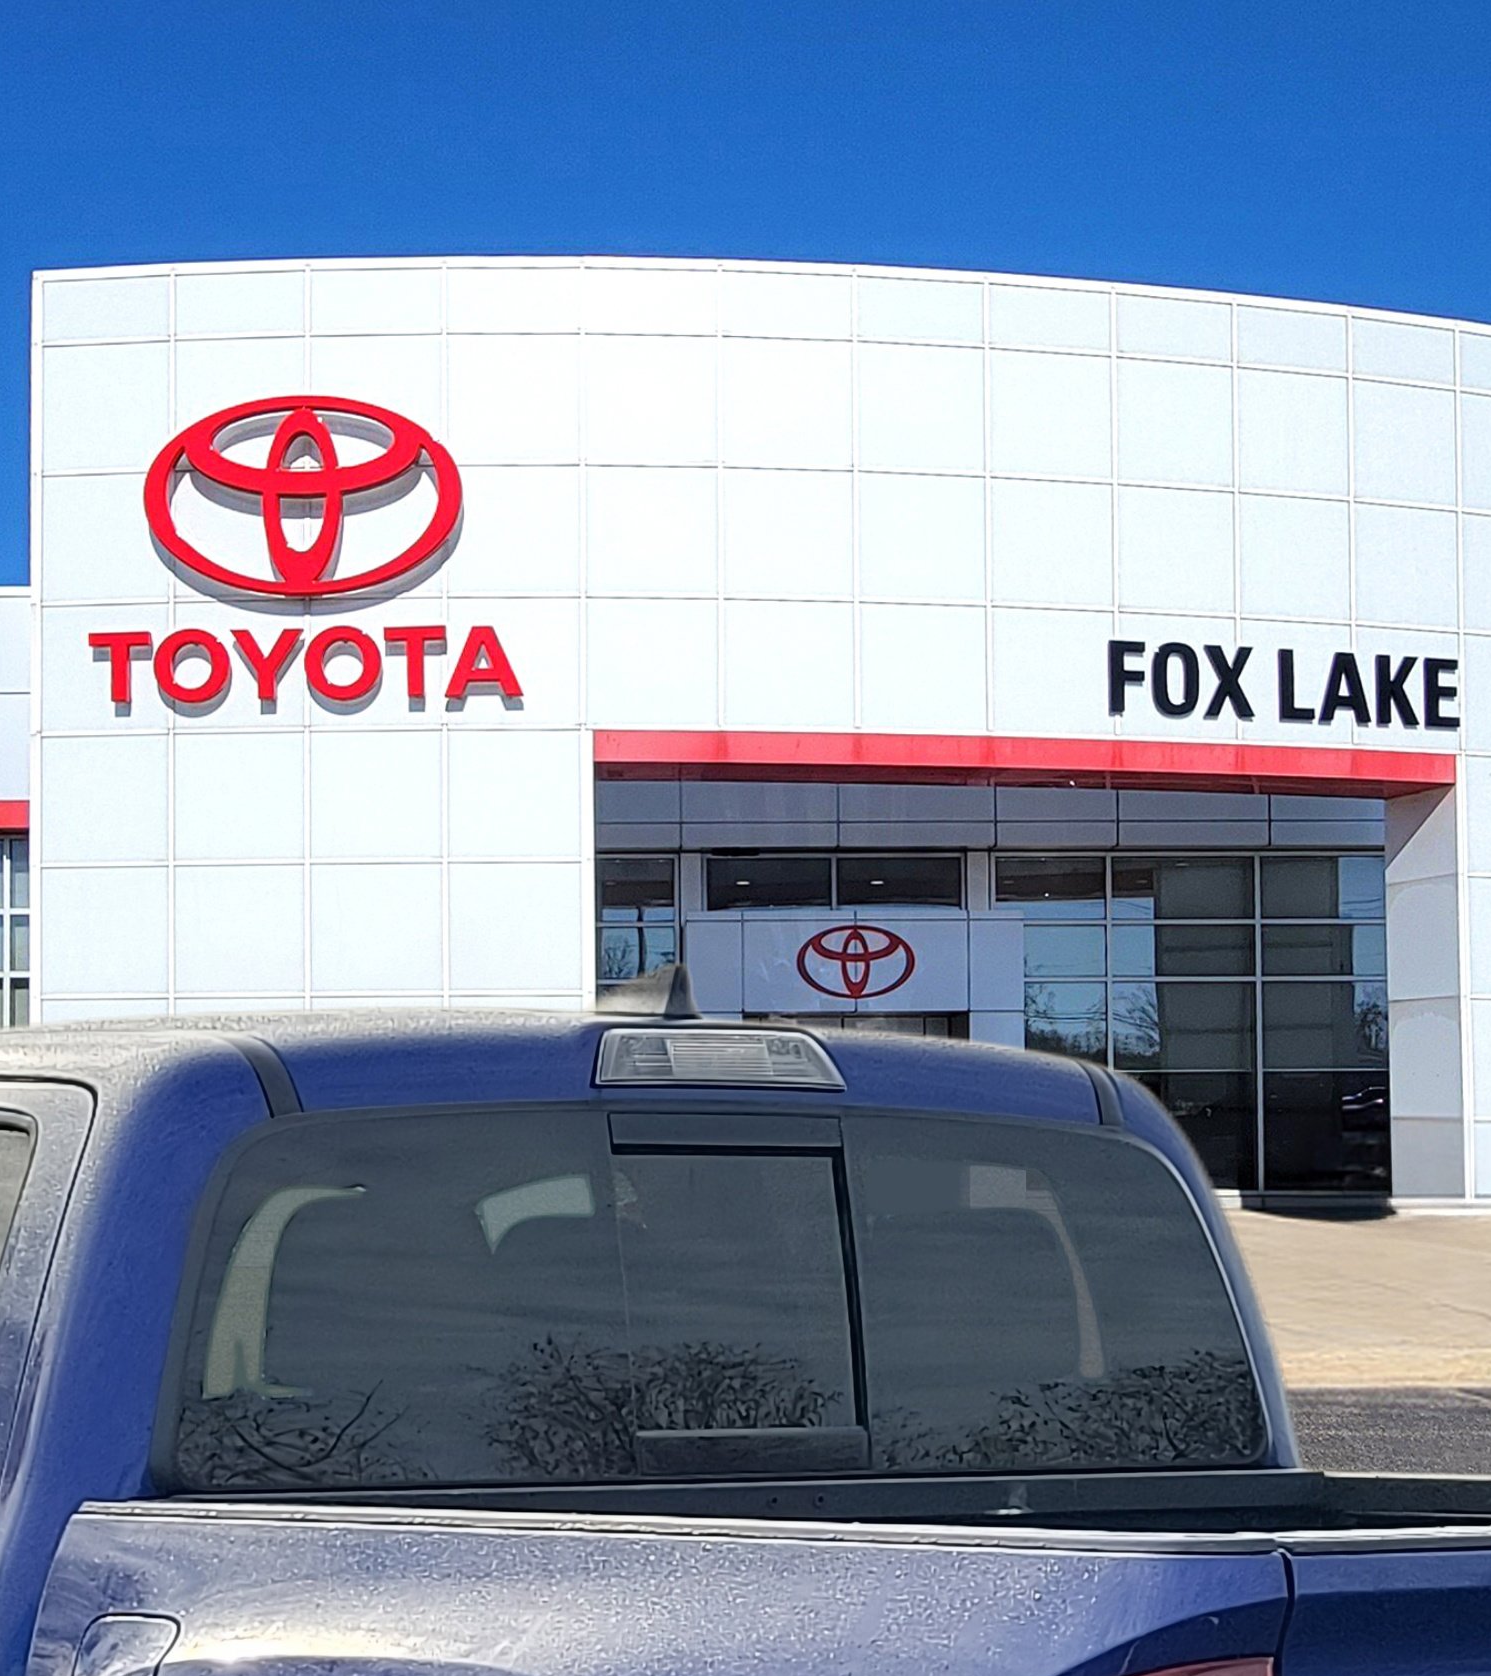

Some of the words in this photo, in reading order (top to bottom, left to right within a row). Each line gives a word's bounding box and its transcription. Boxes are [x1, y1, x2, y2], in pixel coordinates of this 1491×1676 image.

[88, 625, 524, 708] TOYOTA
[1108, 640, 1255, 721] FOX
[1277, 648, 1461, 729] LAKE
